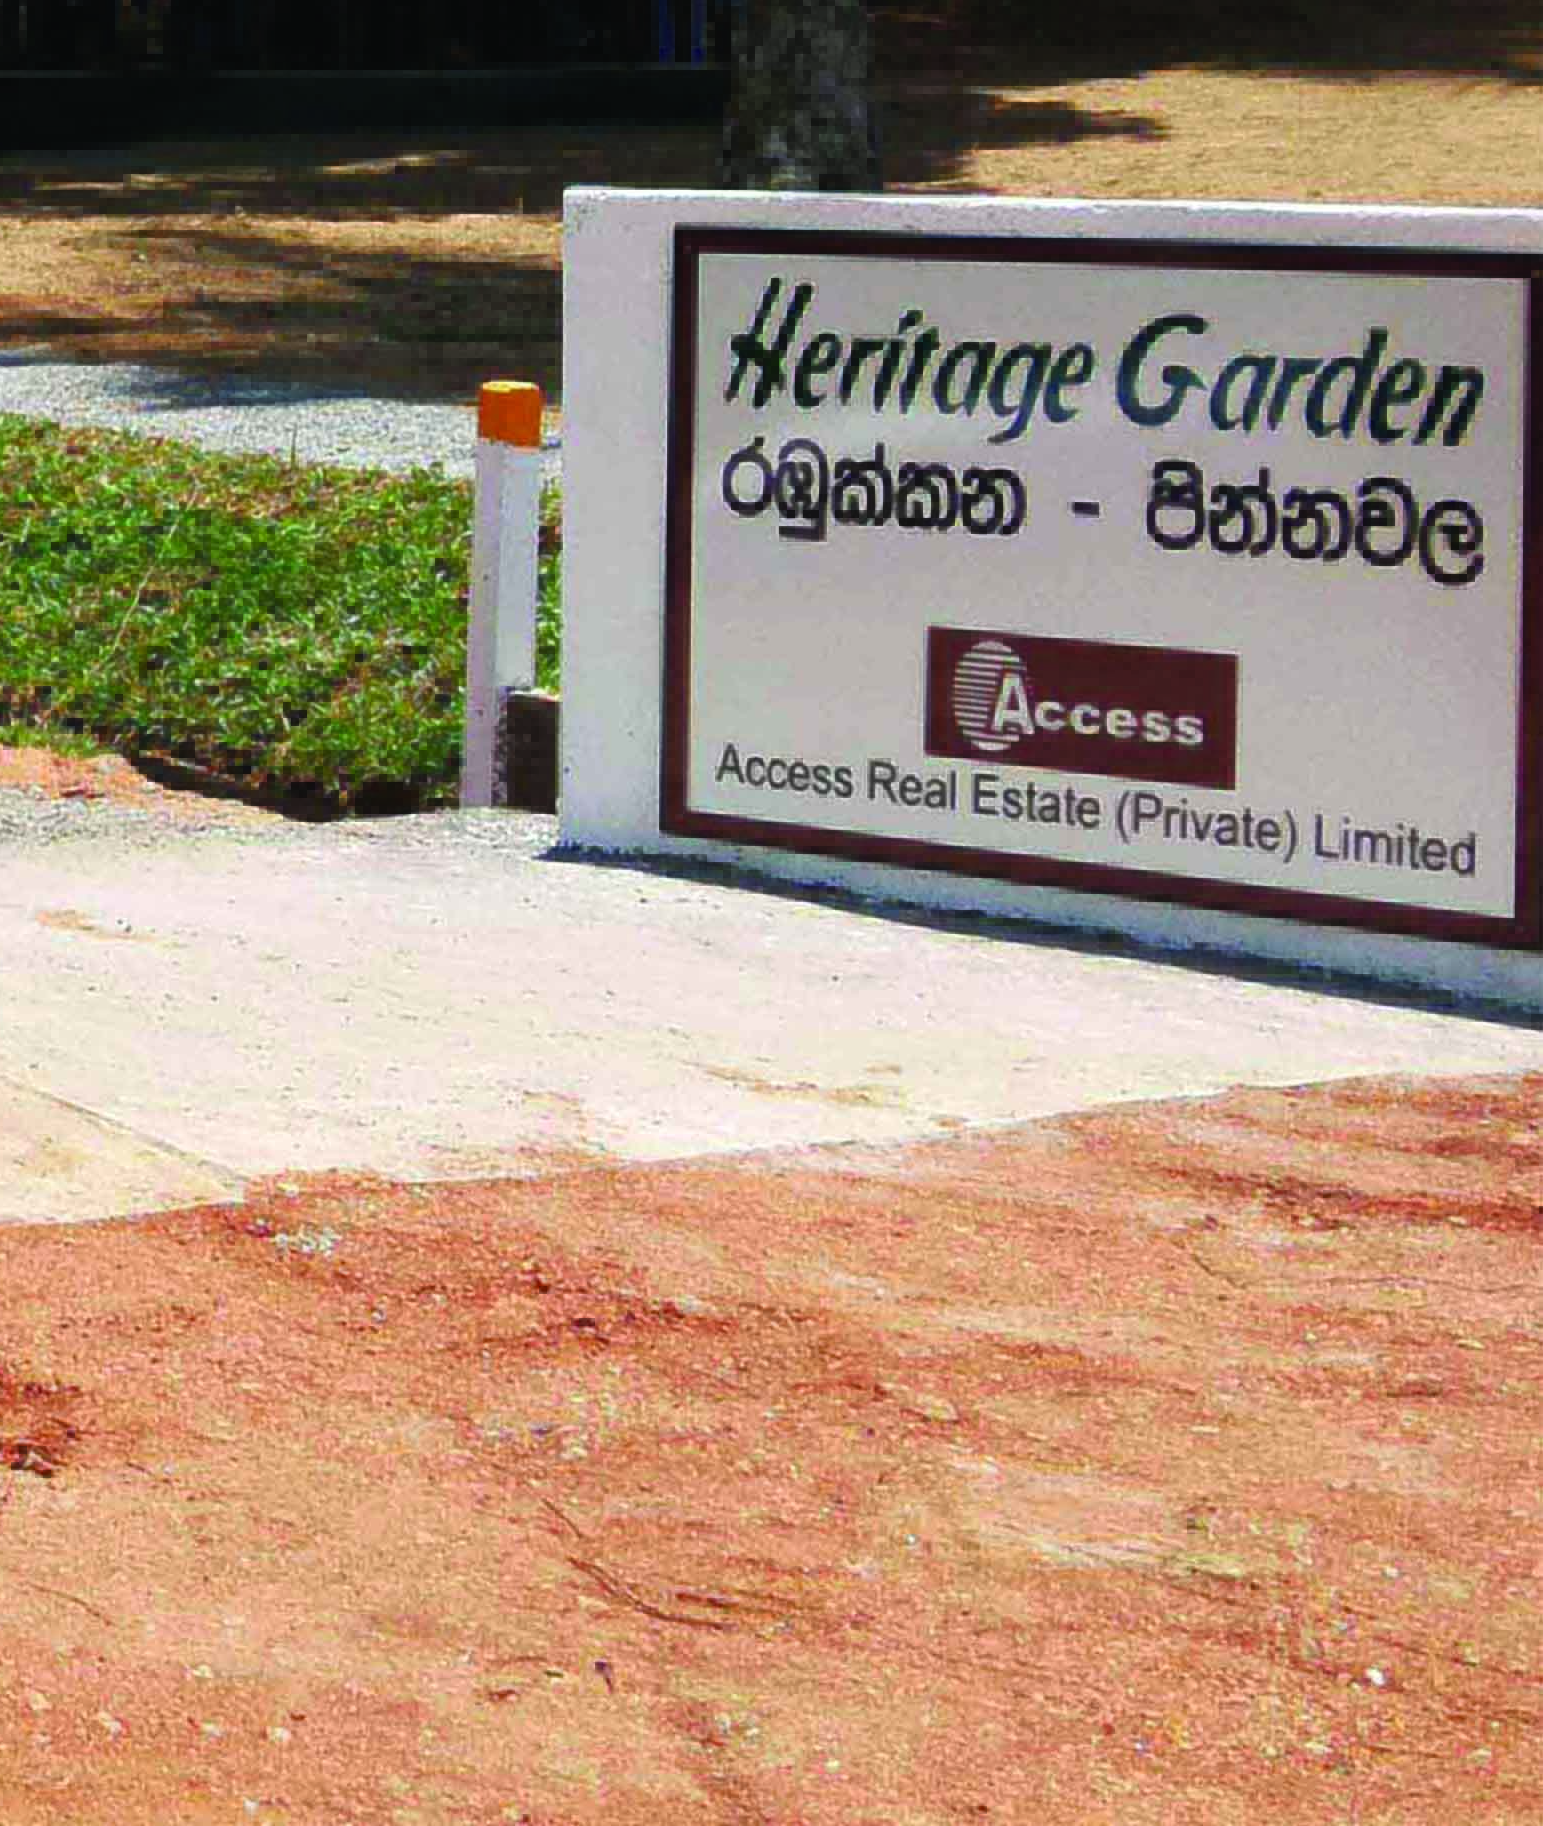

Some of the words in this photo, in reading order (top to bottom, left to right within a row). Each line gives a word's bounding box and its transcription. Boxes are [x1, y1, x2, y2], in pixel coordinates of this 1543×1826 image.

[724, 276, 1095, 443] Heritage
[1117, 313, 1484, 447] Garden
[723, 437, 1027, 542] රඹුක්කන
[1147, 460, 1485, 586] පින්නවල
[991, 672, 1204, 747] Access
[715, 742, 853, 799] Access
[867, 759, 957, 812] Real
[970, 773, 1101, 830] Estate
[1116, 789, 1299, 863] (Private)
[1314, 812, 1477, 875] Limited
